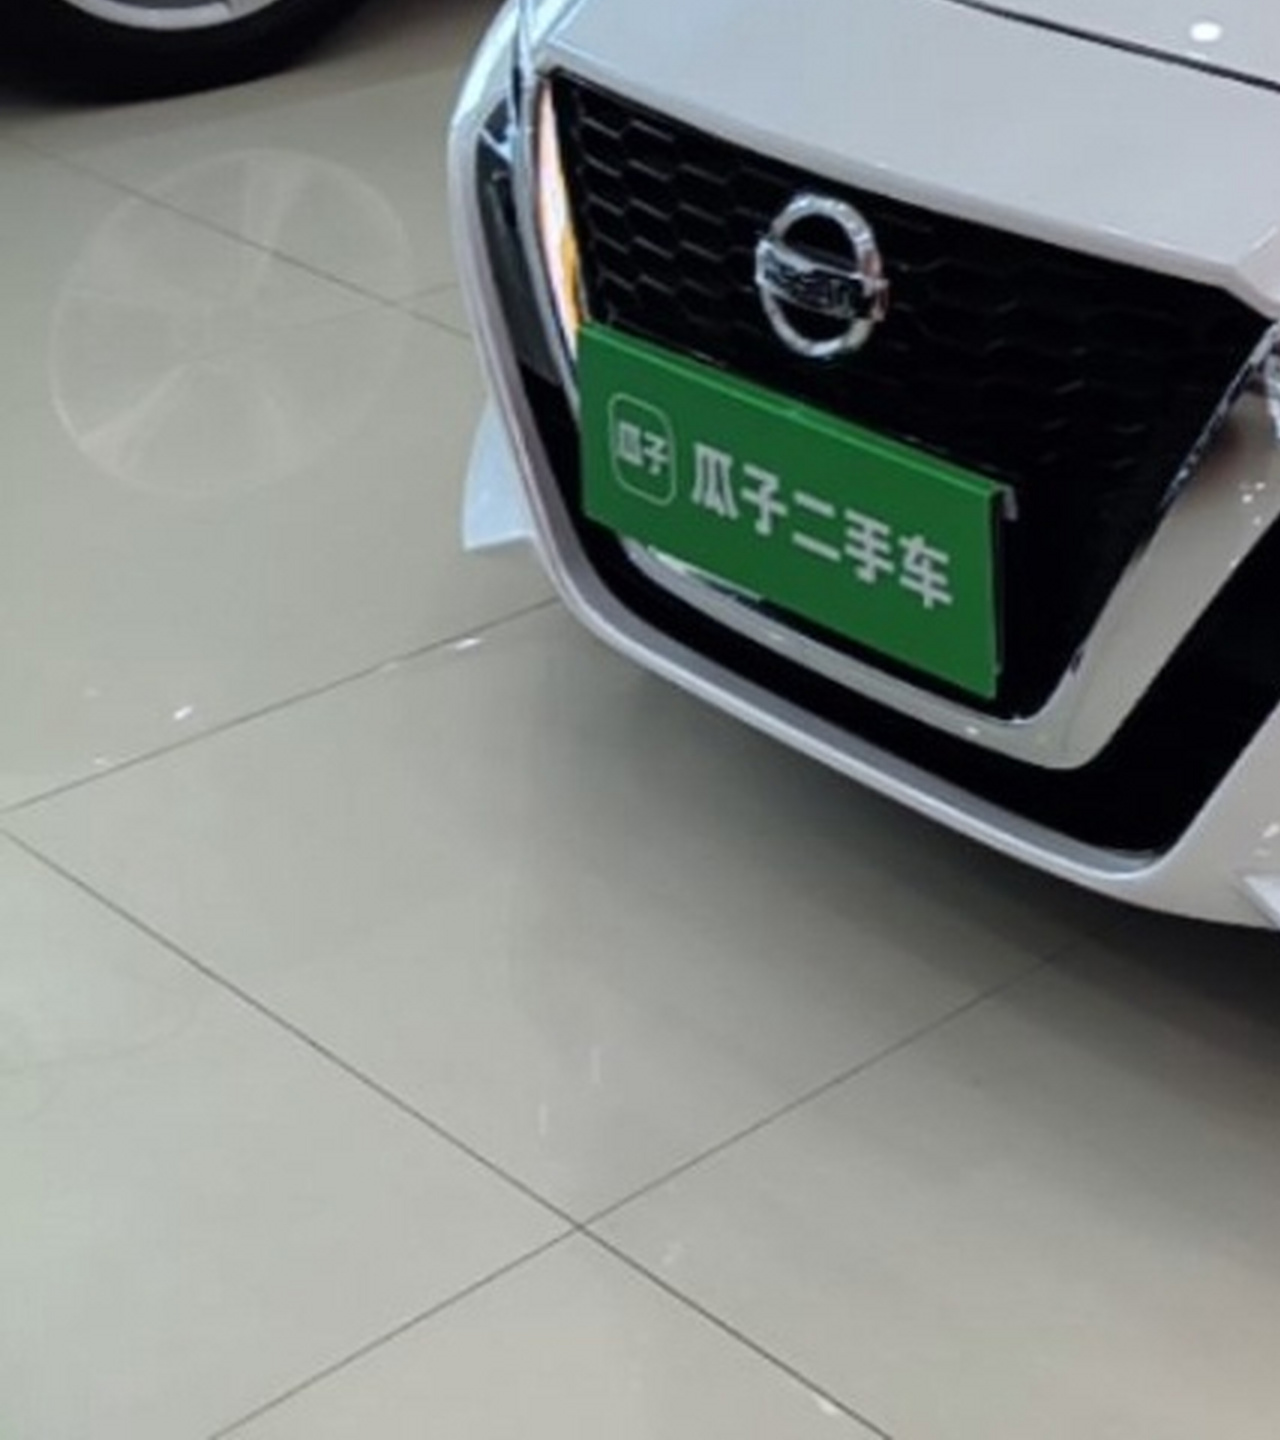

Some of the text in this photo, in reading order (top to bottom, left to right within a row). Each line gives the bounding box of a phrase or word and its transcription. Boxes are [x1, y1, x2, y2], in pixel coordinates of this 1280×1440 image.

[619, 420, 953, 609] 瓜子 瓜子二手车
